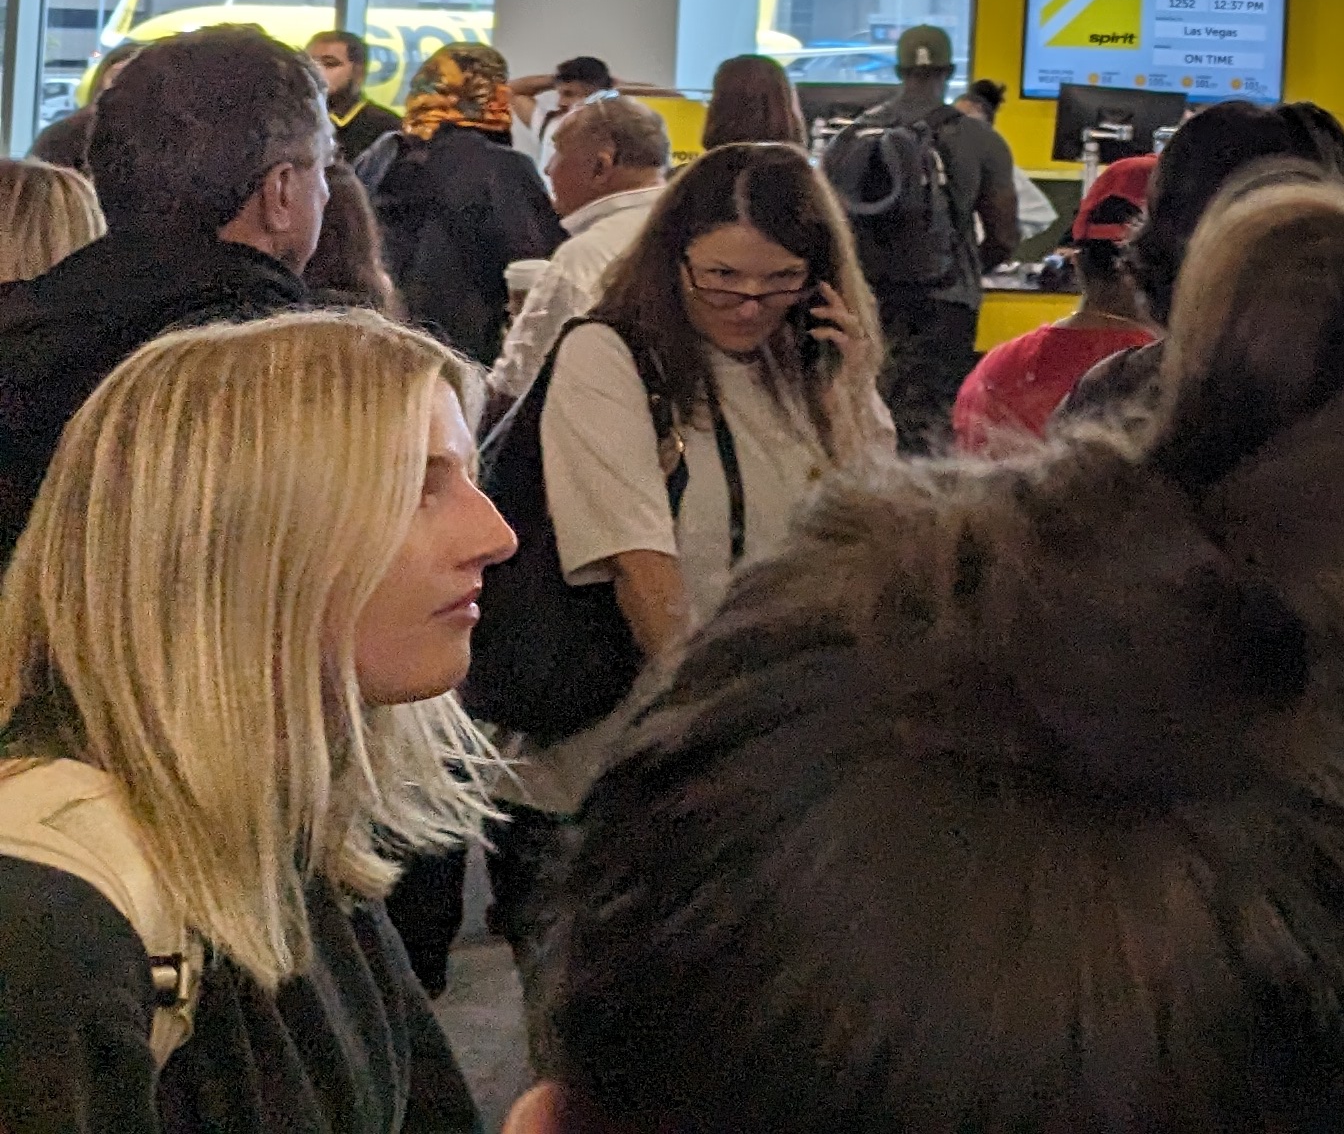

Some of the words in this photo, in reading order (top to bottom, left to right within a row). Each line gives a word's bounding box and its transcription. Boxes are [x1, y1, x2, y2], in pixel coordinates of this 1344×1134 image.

[1246, 1, 1265, 11] PM
[1089, 33, 1135, 46] spirit
[1183, 26, 1202, 36] Las
[1204, 27, 1238, 40] Vegas
[1184, 53, 1203, 64] ON
[1205, 54, 1235, 66] TIME
